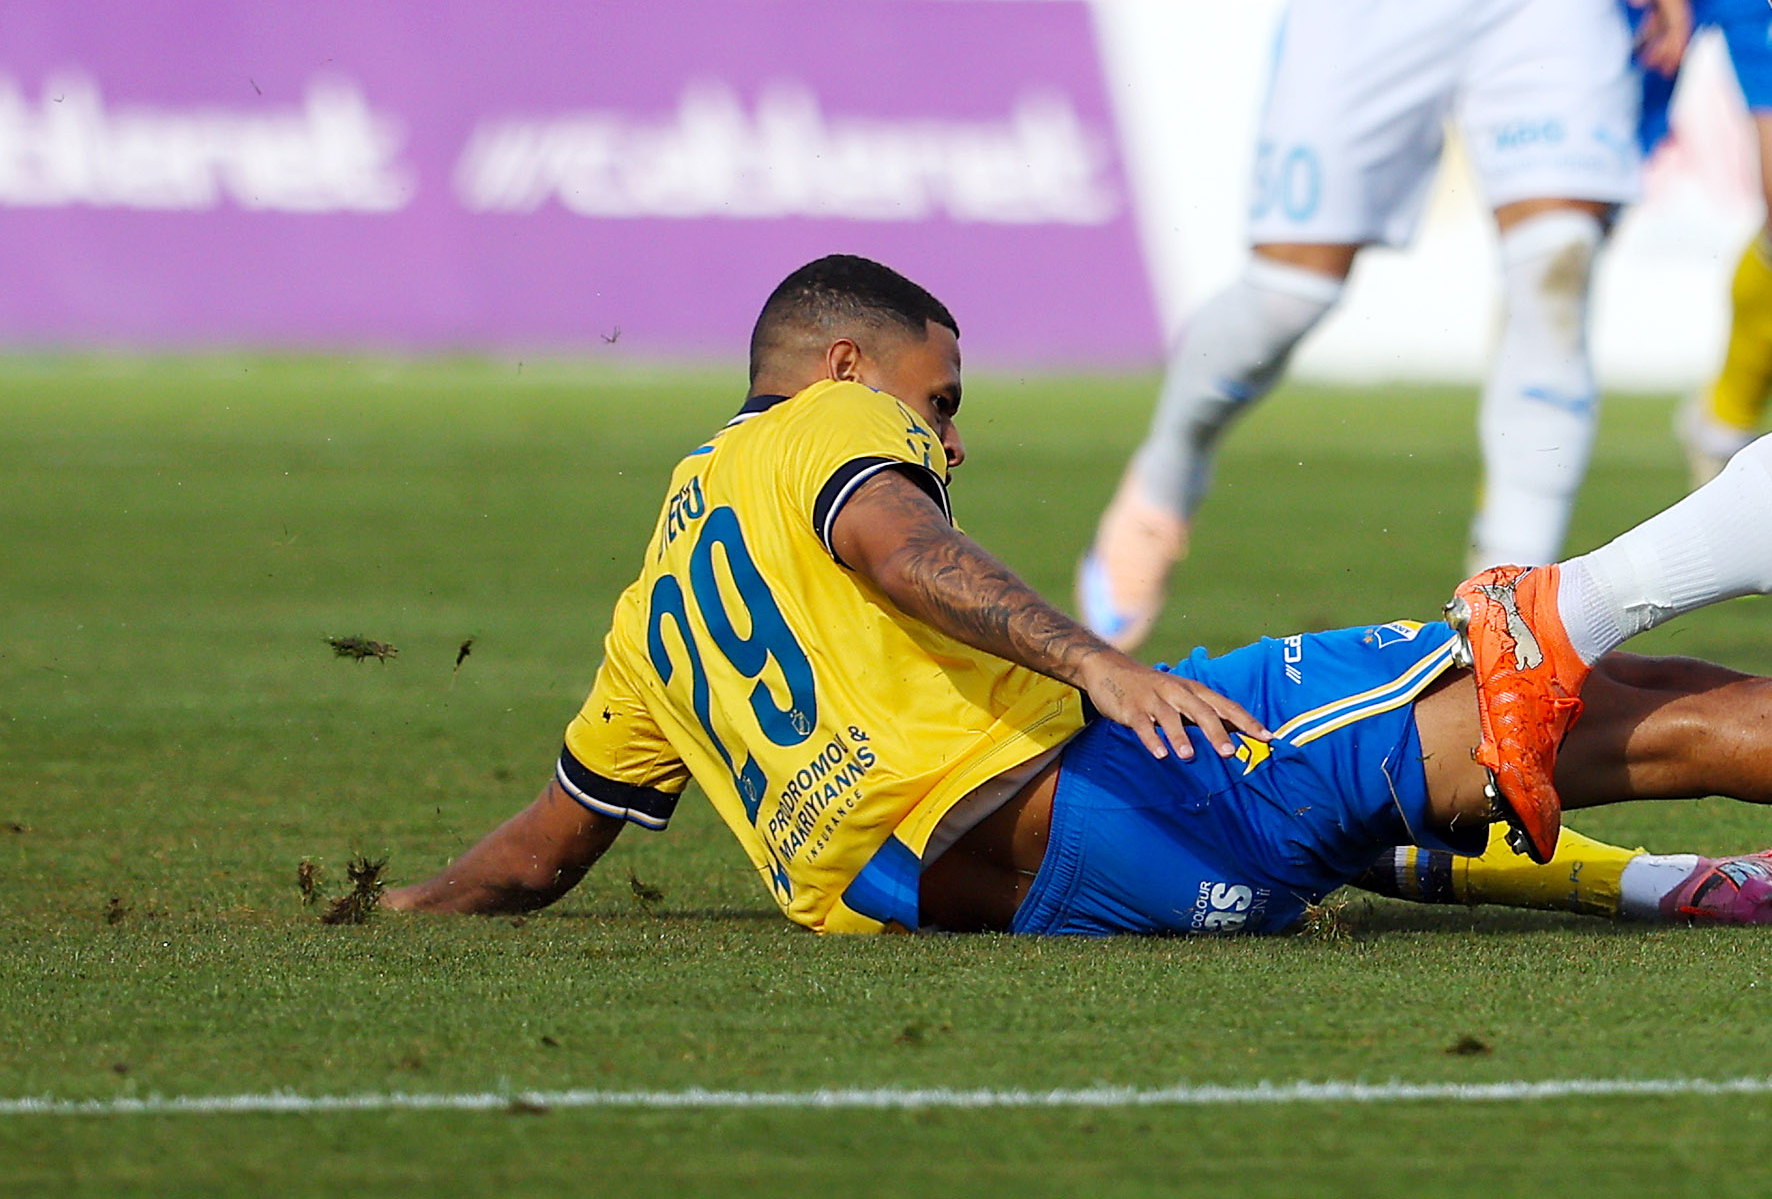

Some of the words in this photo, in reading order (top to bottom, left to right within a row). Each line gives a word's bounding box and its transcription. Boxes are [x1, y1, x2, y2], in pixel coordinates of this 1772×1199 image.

[647, 505, 819, 828] 29
[848, 725, 871, 742] &
[805, 788, 863, 864] INSURANCE
[1191, 880, 1212, 928] COLOUR
